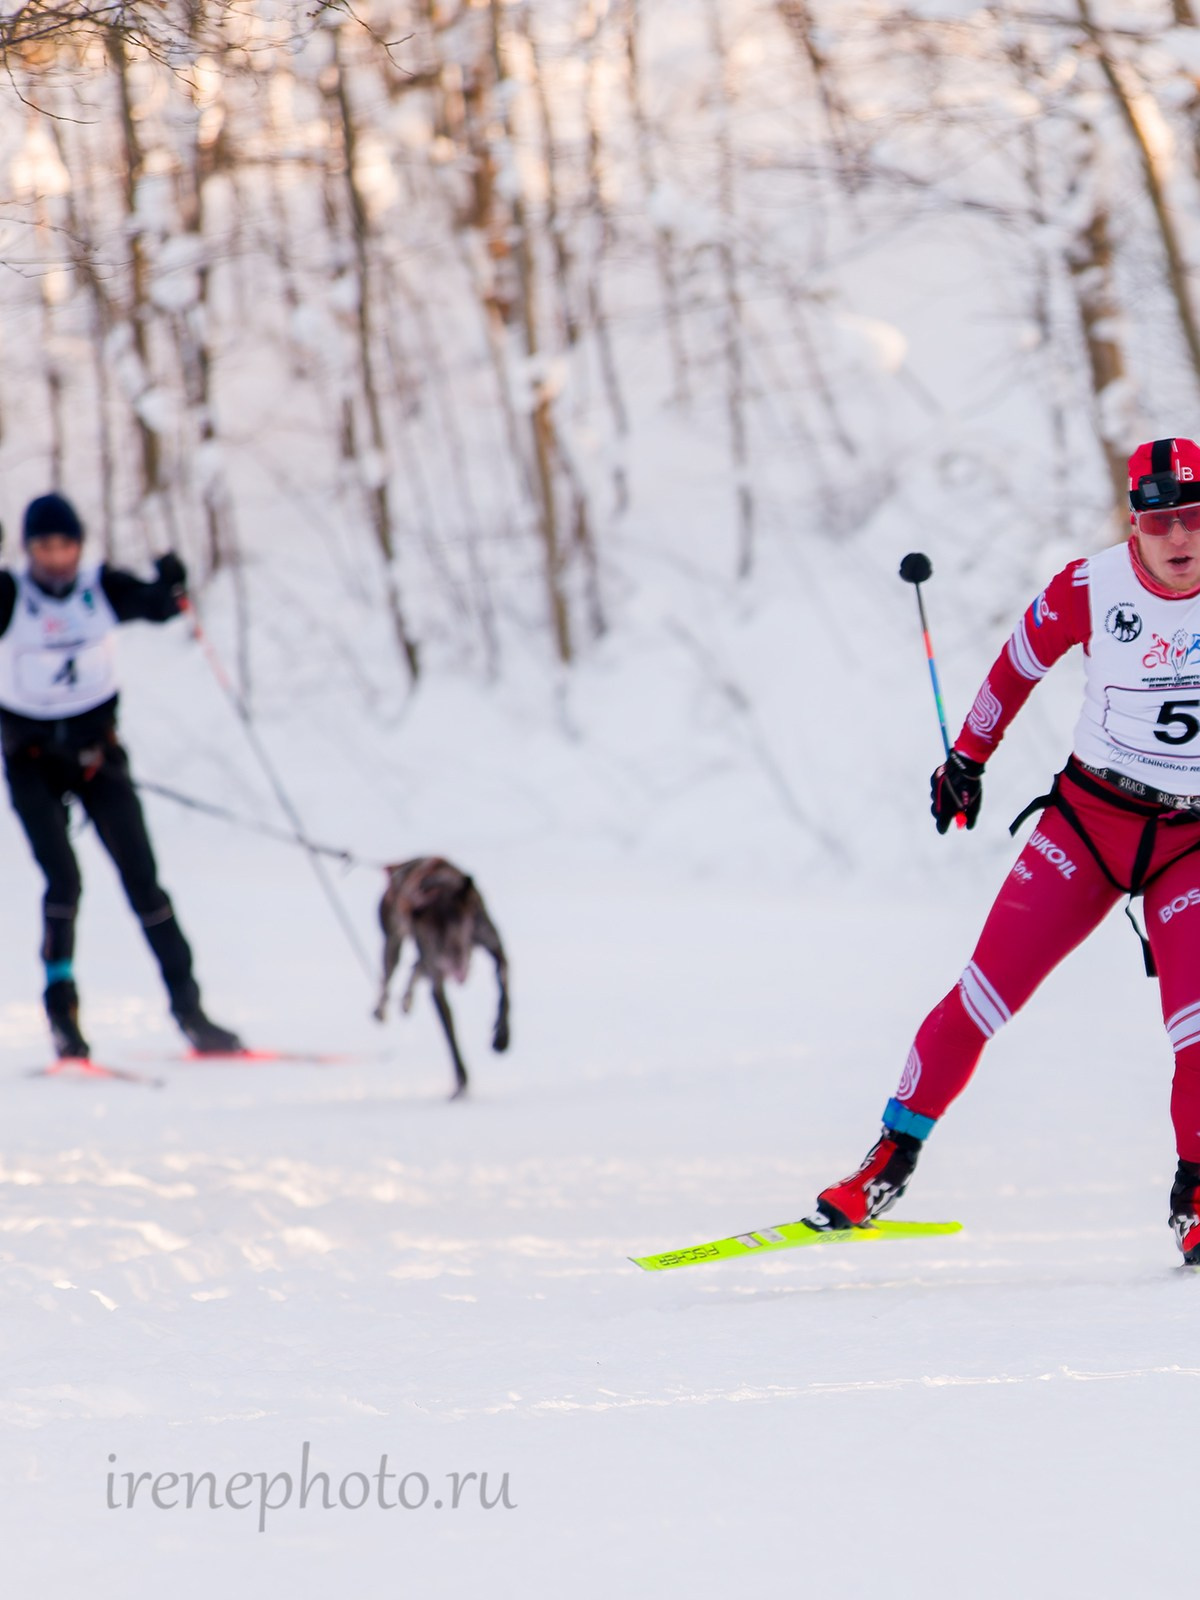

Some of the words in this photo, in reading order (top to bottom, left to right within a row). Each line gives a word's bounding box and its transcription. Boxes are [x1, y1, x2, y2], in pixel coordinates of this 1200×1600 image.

[52, 655, 78, 688] 4
[1153, 699, 1200, 745] 5
[1138, 755, 1188, 771] LENINGRAD
[1030, 830, 1077, 880] UKOIL
